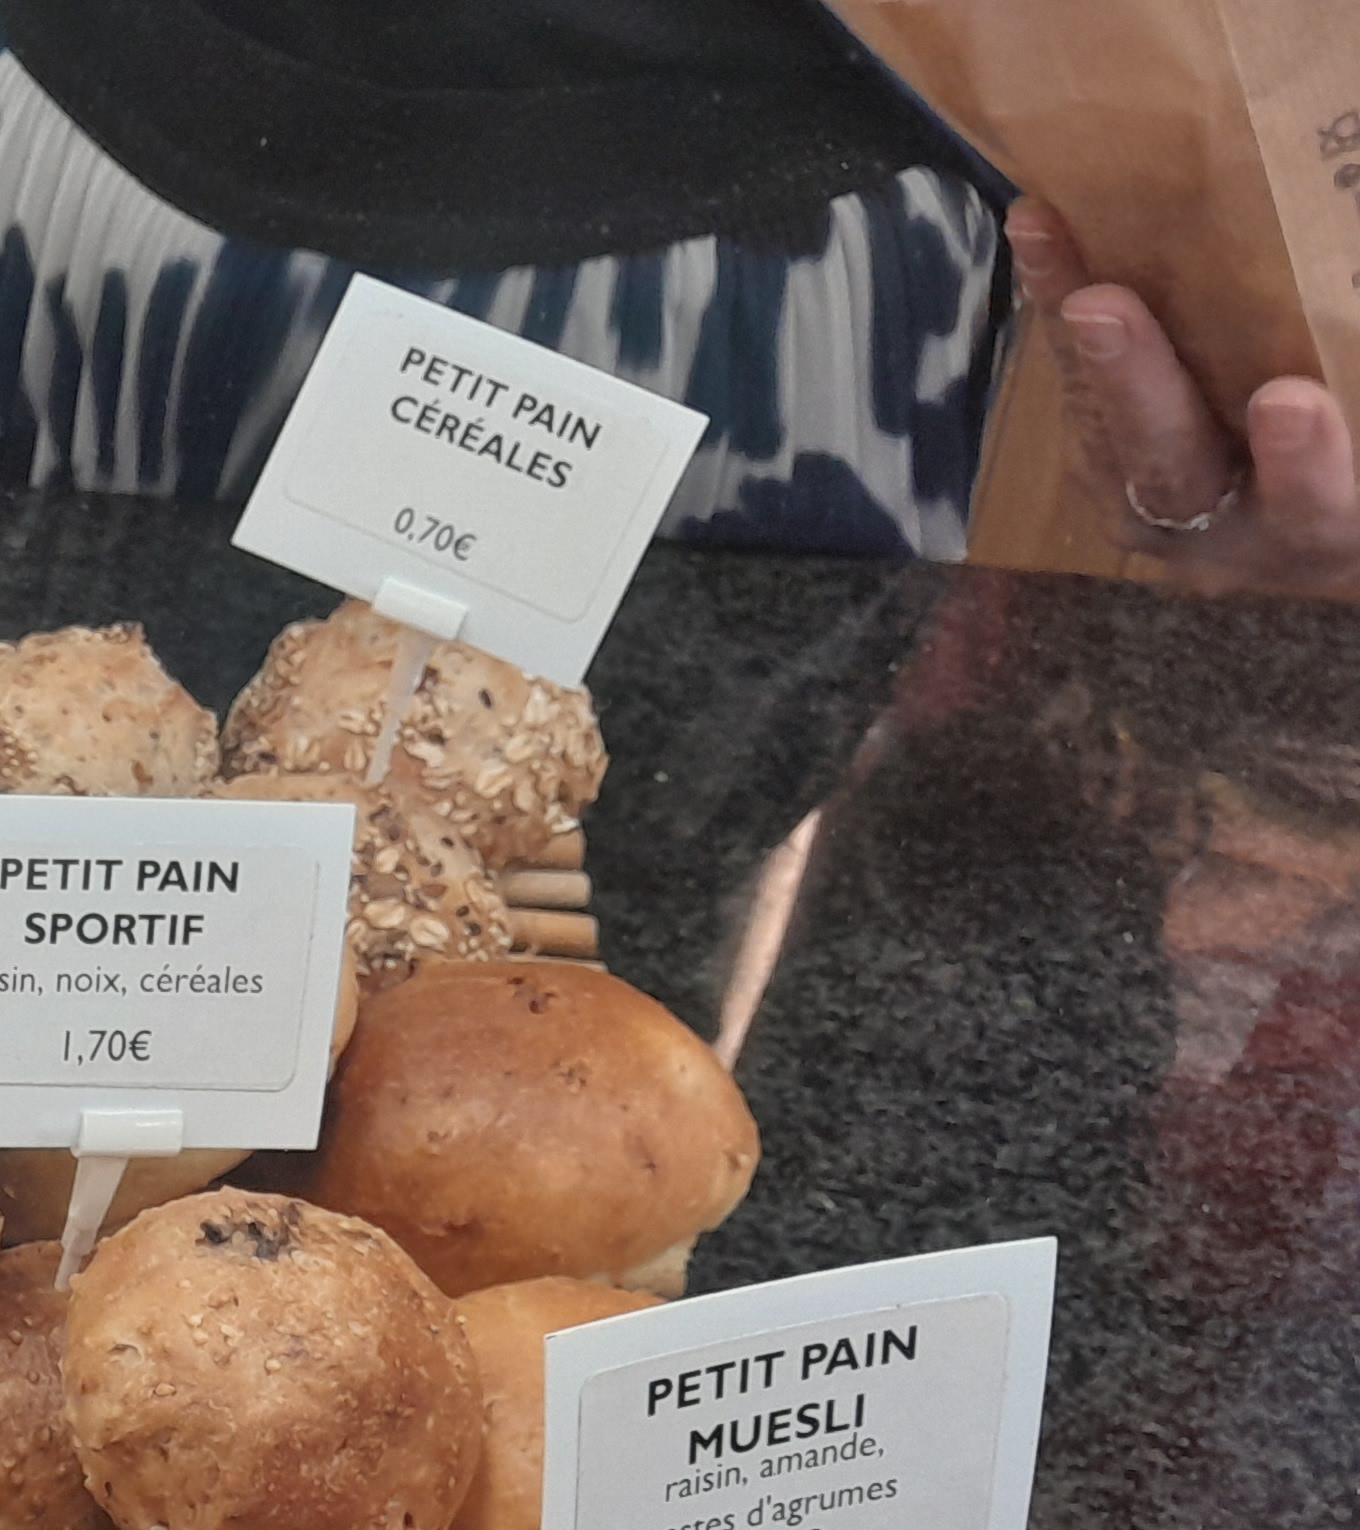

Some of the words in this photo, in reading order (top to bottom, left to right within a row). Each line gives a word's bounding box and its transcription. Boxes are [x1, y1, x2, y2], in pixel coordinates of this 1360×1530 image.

[400, 346, 510, 408] PETIT
[512, 393, 602, 449] PAIN
[390, 395, 573, 488] CÉRÉALES
[394, 507, 477, 562] 0,70€
[0, 858, 124, 891] PETIT
[136, 859, 239, 893] PAIN
[24, 912, 205, 946] SPORTIF
[56, 965, 127, 998] noix,
[139, 963, 263, 994] céréales
[63, 1029, 152, 1066] 1,70€
[647, 1350, 786, 1417] PETIT
[801, 1325, 918, 1381] PAIN
[688, 1393, 865, 1466] MUESLI
[665, 1466, 748, 1503] raisin,
[759, 1432, 884, 1479] amande,
[746, 1478, 898, 1527] d'agrumes
